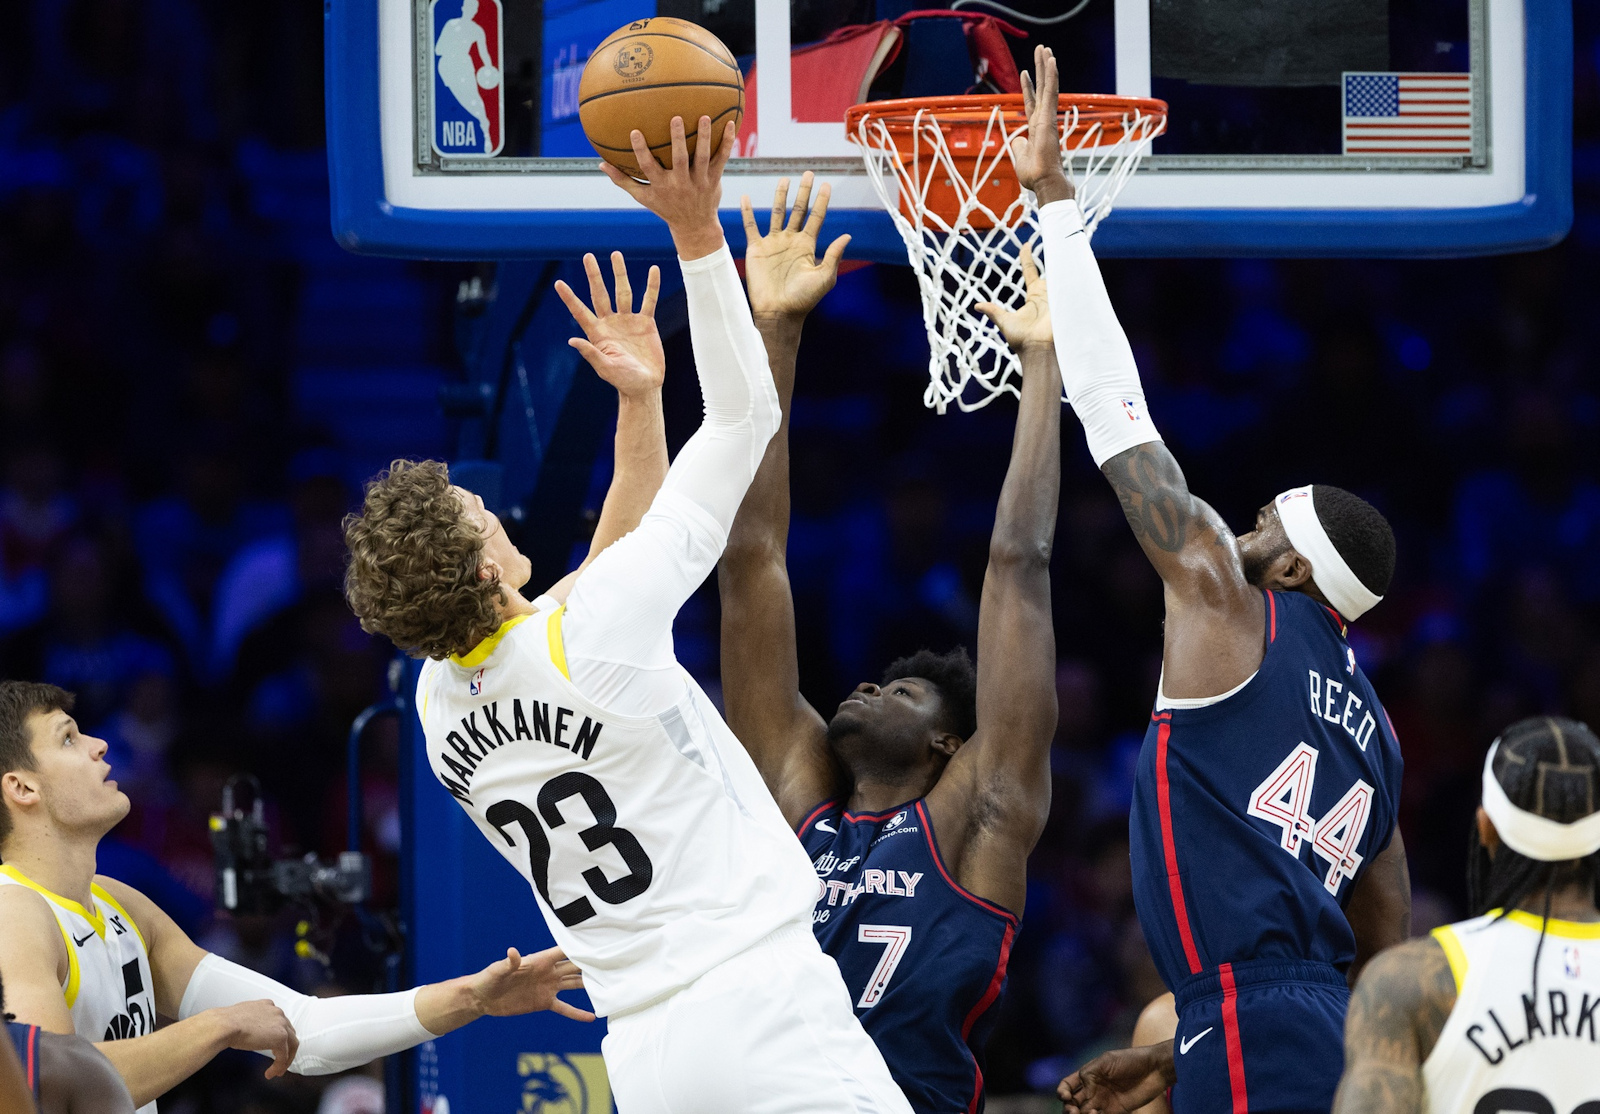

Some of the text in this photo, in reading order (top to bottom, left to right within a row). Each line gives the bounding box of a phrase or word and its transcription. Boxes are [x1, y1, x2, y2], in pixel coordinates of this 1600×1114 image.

[442, 121, 477, 147] NBA
[440, 698, 604, 807] MARKKANEN
[1308, 669, 1376, 751] REED
[485, 771, 653, 928] 23
[1246, 740, 1375, 897] 44
[837, 855, 861, 873] of
[857, 923, 913, 1009] 7
